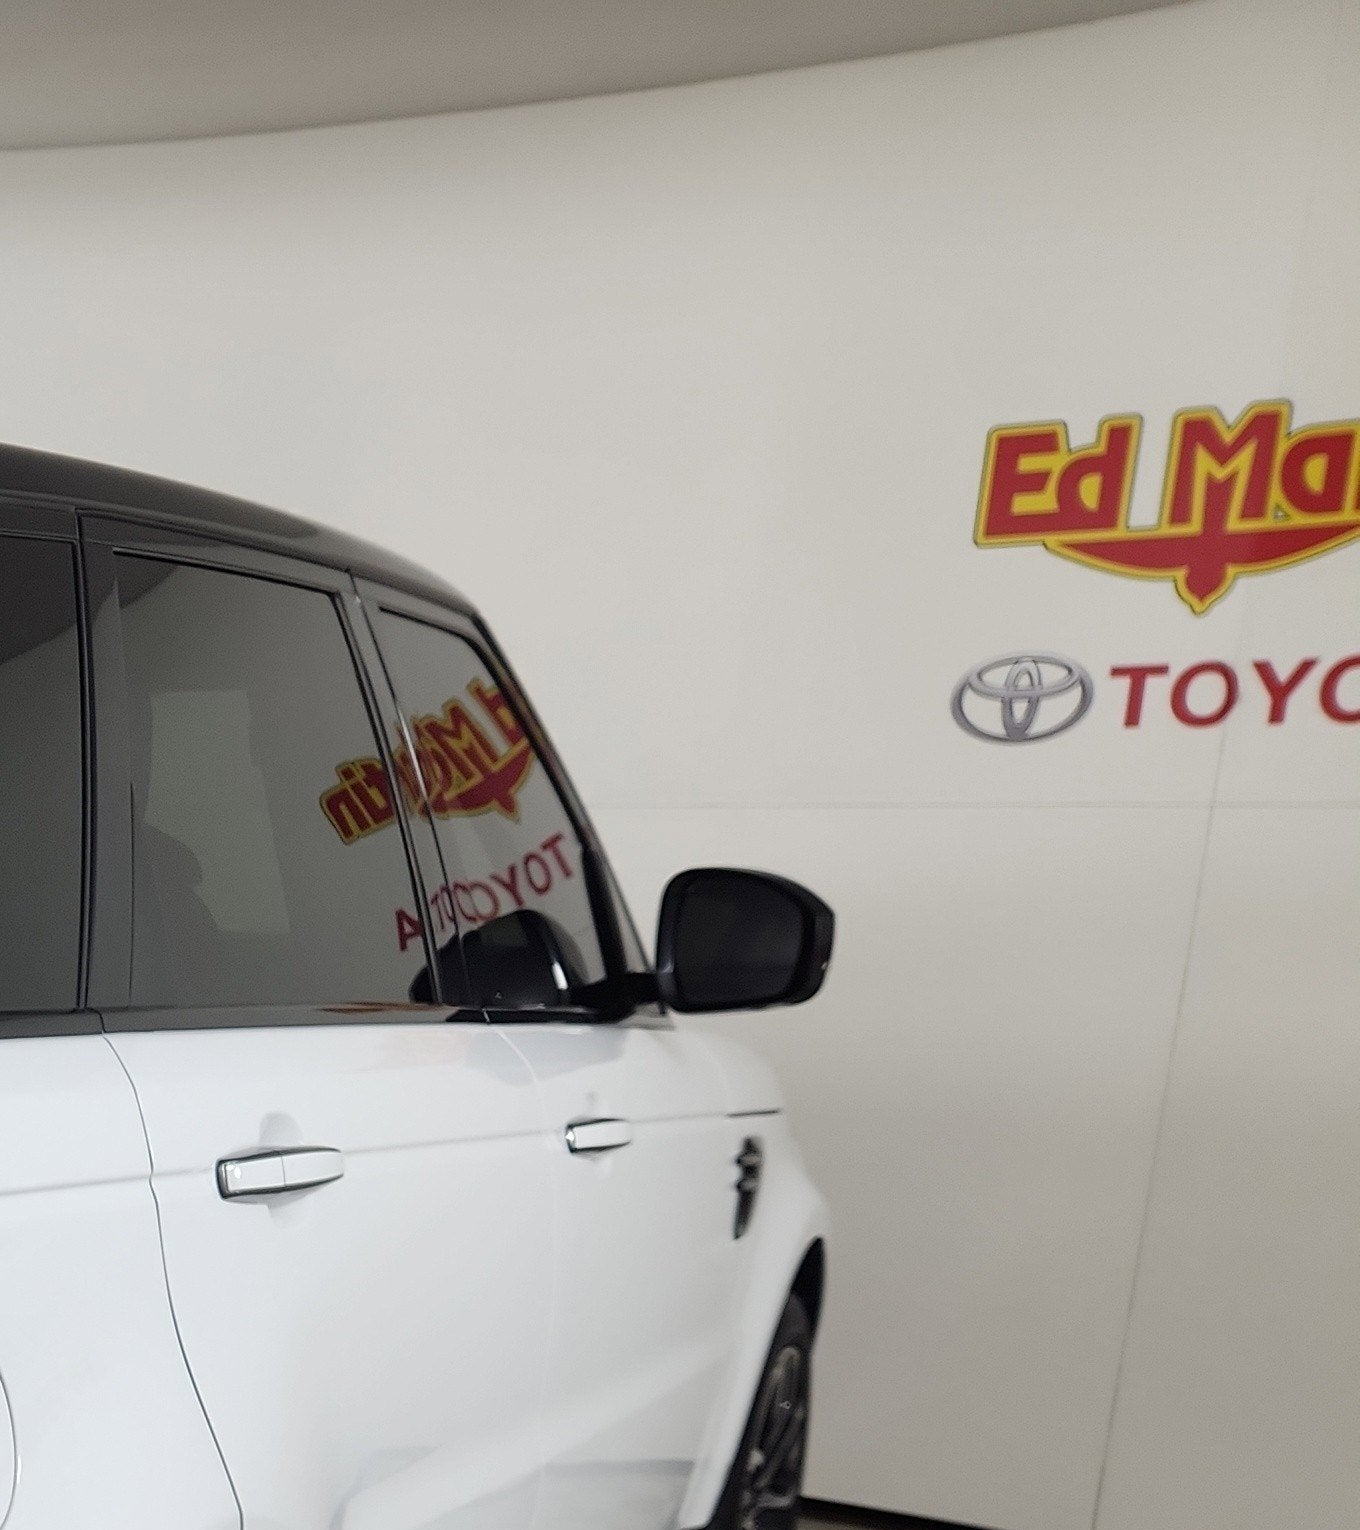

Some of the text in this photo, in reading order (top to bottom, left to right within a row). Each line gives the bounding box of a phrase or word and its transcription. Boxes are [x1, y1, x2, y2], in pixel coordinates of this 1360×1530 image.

[974, 399, 1360, 547] Ed Ma
[1110, 655, 1360, 728] TOYO
